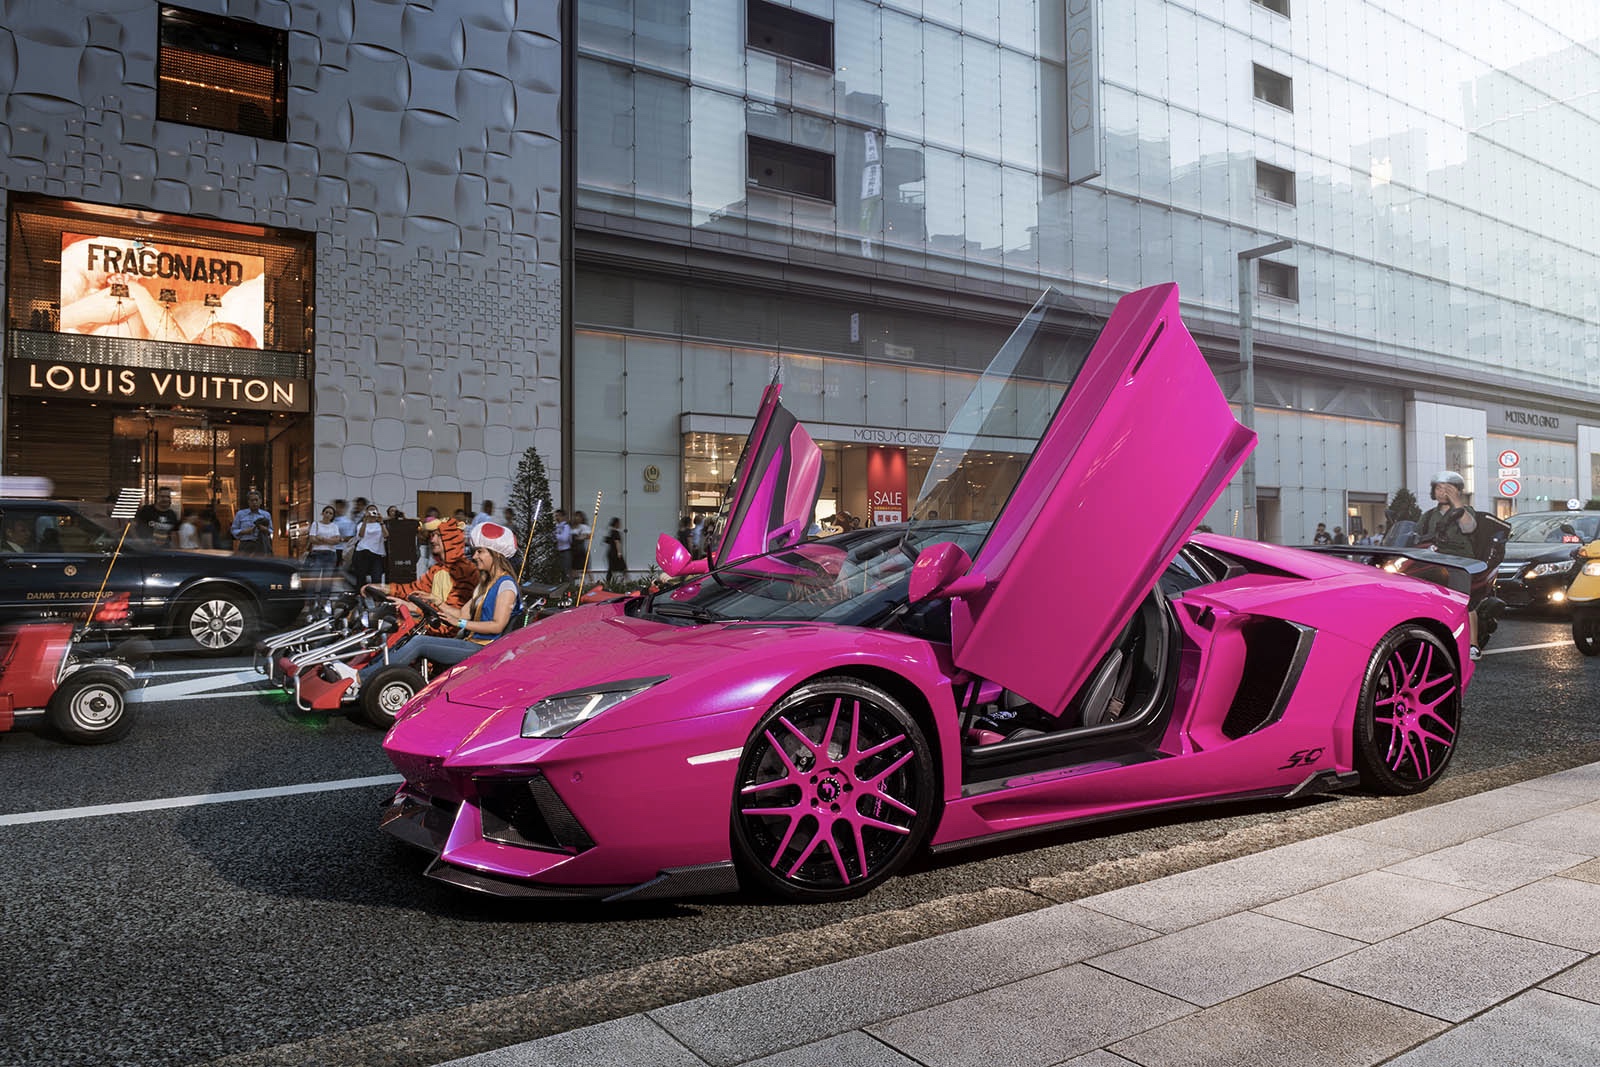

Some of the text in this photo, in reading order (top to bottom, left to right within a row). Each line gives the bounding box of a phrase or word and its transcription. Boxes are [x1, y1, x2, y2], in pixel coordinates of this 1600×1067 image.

[87, 243, 243, 286] FRAGONARD
[29, 363, 294, 404] LOUIS VUITTON
[873, 491, 902, 505] SALE
[26, 591, 114, 600] DAIWA TAXI GROUP
